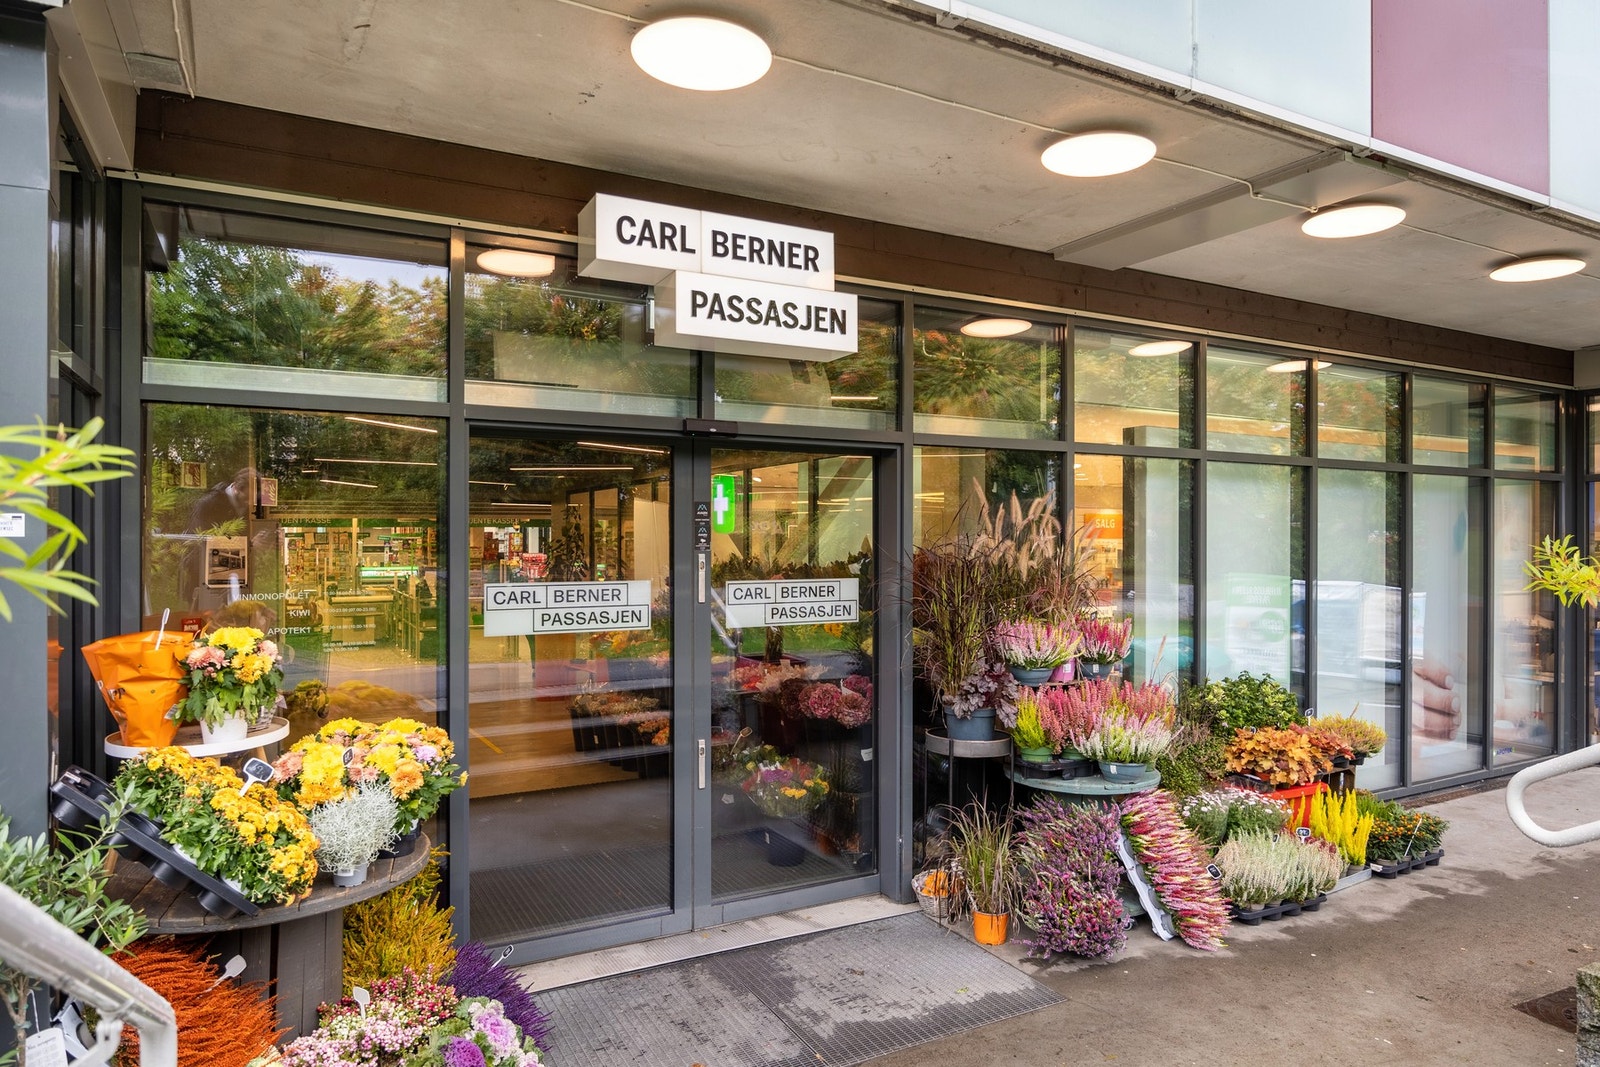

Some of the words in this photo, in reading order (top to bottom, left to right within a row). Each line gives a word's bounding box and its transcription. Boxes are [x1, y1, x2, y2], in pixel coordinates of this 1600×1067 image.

[615, 215, 697, 255] CARL
[711, 229, 820, 273] BERNER
[690, 289, 847, 336] PASSASJEN
[1095, 518, 1116, 529] SALG
[493, 590, 541, 605] CARL
[553, 588, 622, 604] BERNER
[733, 587, 771, 601] CARL
[780, 585, 835, 599] BERNER
[289, 609, 311, 617] KIWI
[541, 609, 642, 627] PASSASJEN
[771, 604, 852, 620] PASSASJEN
